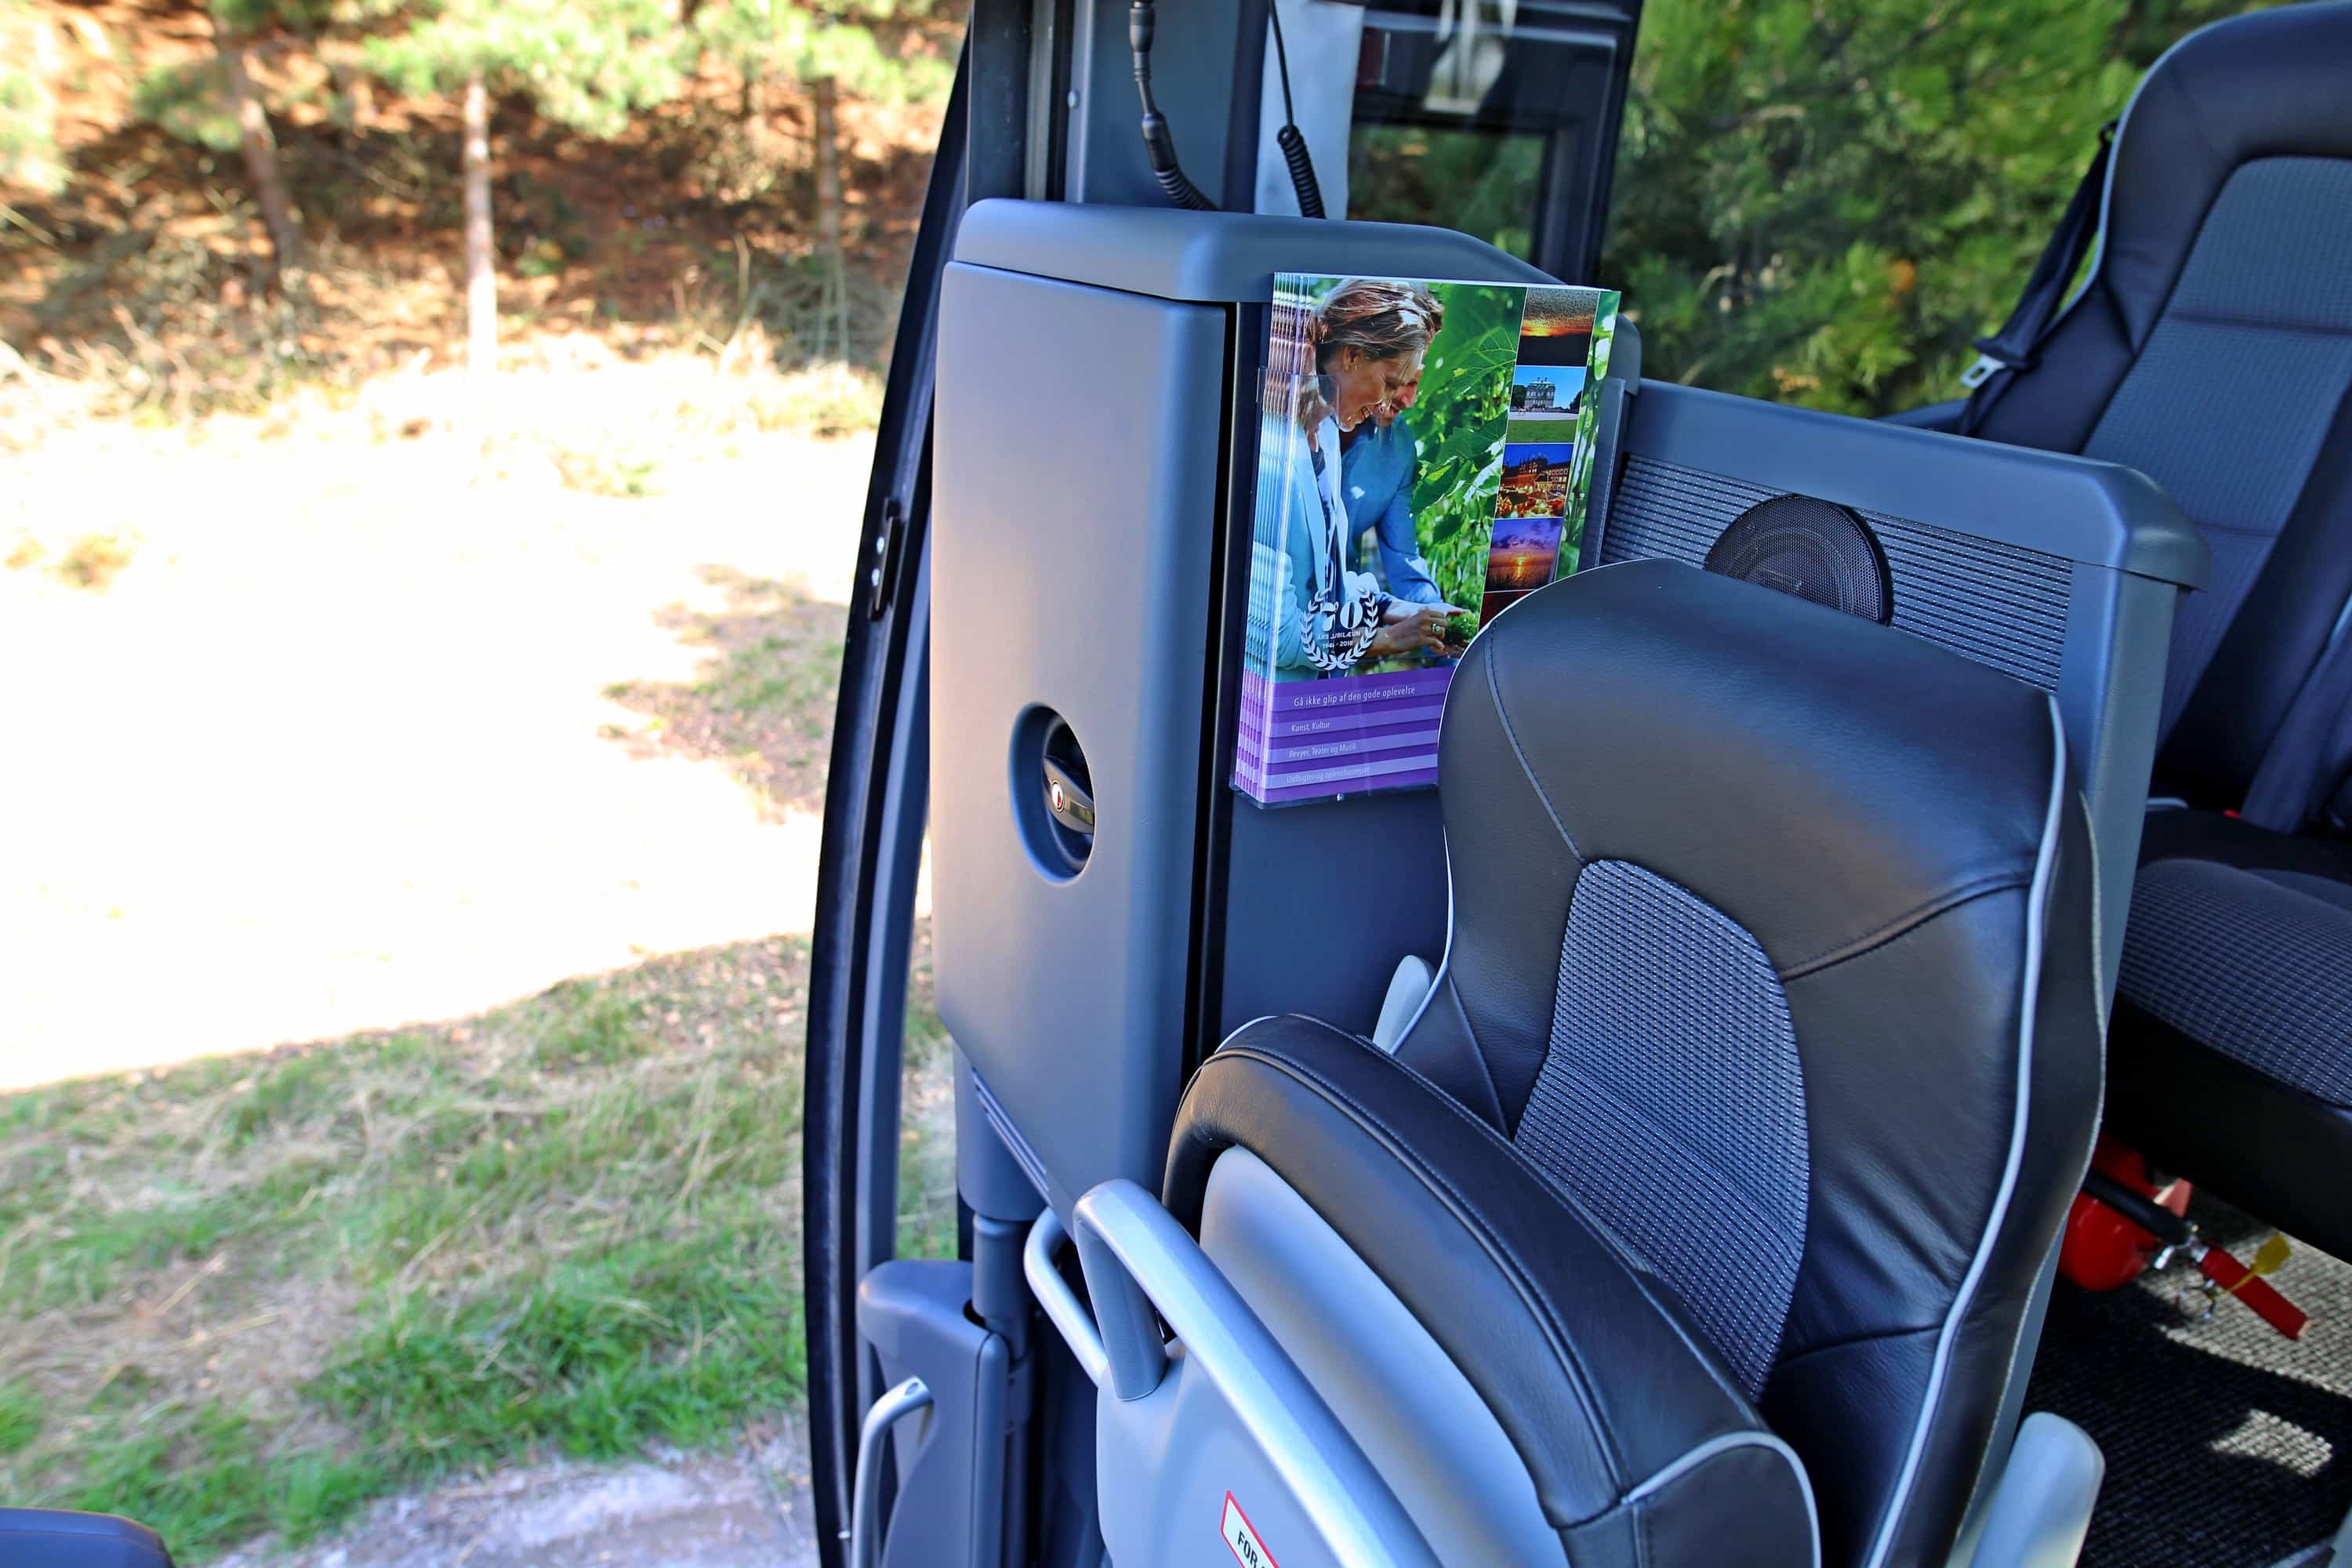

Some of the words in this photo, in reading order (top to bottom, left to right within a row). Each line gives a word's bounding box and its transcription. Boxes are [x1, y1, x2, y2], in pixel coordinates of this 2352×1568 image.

[1320, 601, 1363, 631] 70
[1294, 696, 1304, 706] Gå
[1305, 695, 1320, 706] ikke
[1323, 694, 1338, 706] glip
[1339, 692, 1347, 702] af
[1348, 691, 1361, 701] den
[1382, 684, 1415, 698] oplevelse
[1312, 720, 1330, 731] Kultur
[1237, 1530, 1258, 1568] FOR
